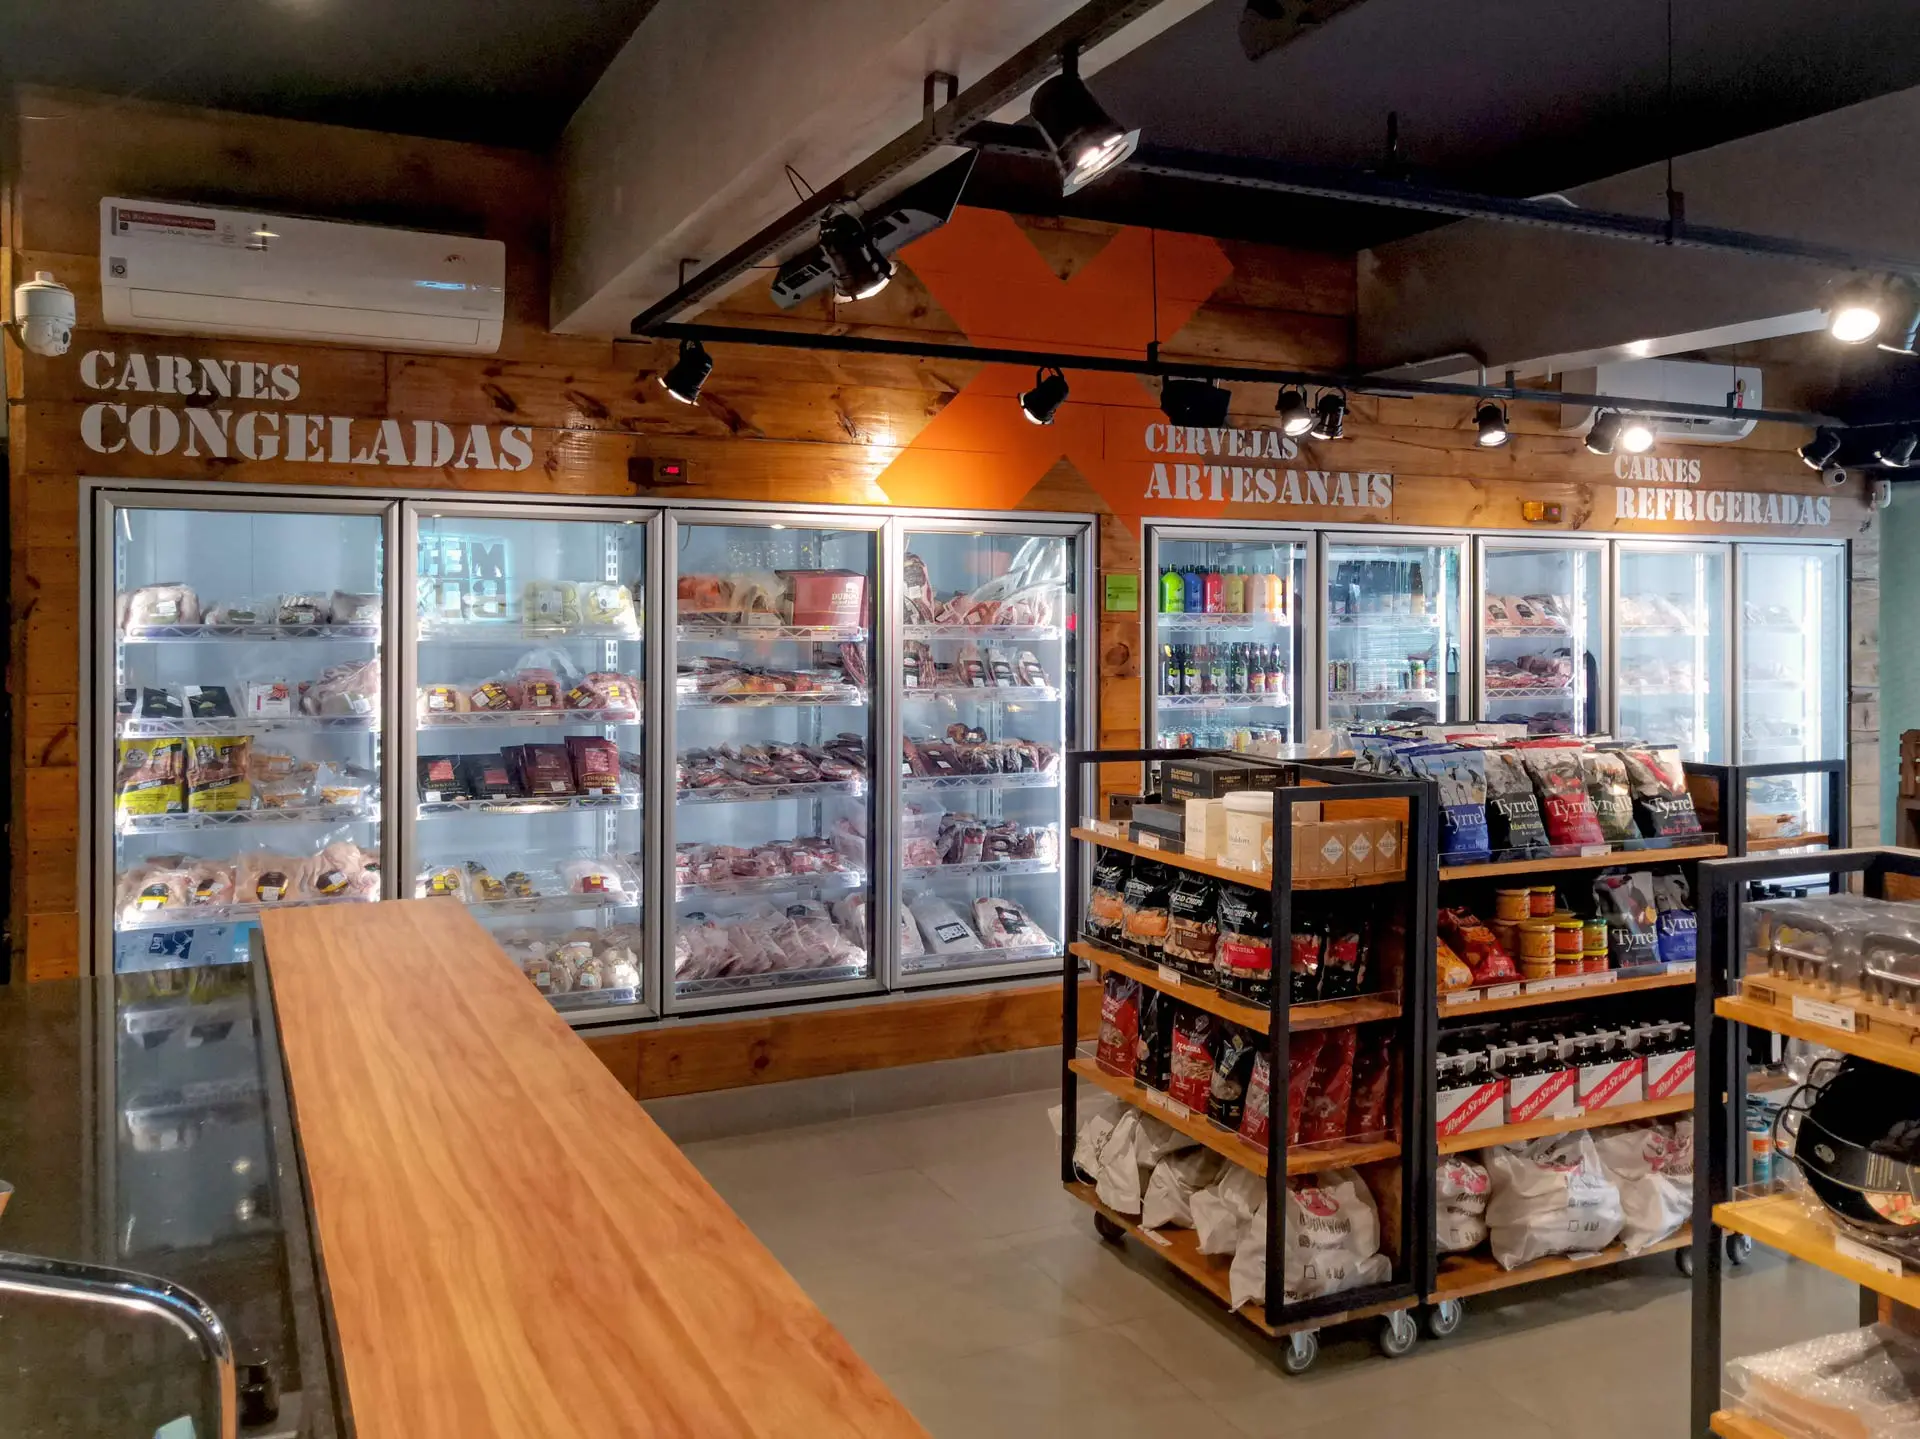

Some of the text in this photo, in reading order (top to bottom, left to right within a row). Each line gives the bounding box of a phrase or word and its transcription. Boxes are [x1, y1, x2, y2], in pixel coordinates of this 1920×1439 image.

[79, 350, 300, 401] CARNES
[80, 402, 534, 472] CONGELADAS
[1144, 423, 1299, 460] CERVEJAS
[1144, 462, 1393, 509] ARTESANAIS
[1614, 455, 1701, 484] CARNES
[1615, 486, 1831, 526] REFRIGERADAS
[1519, 1072, 1569, 1121] Red Stripe
[1588, 1060, 1636, 1108] Red Stripe
[1656, 1073, 1675, 1098] Red
[1444, 1110, 1468, 1136] Red
[1466, 1083, 1498, 1116] Stripe
